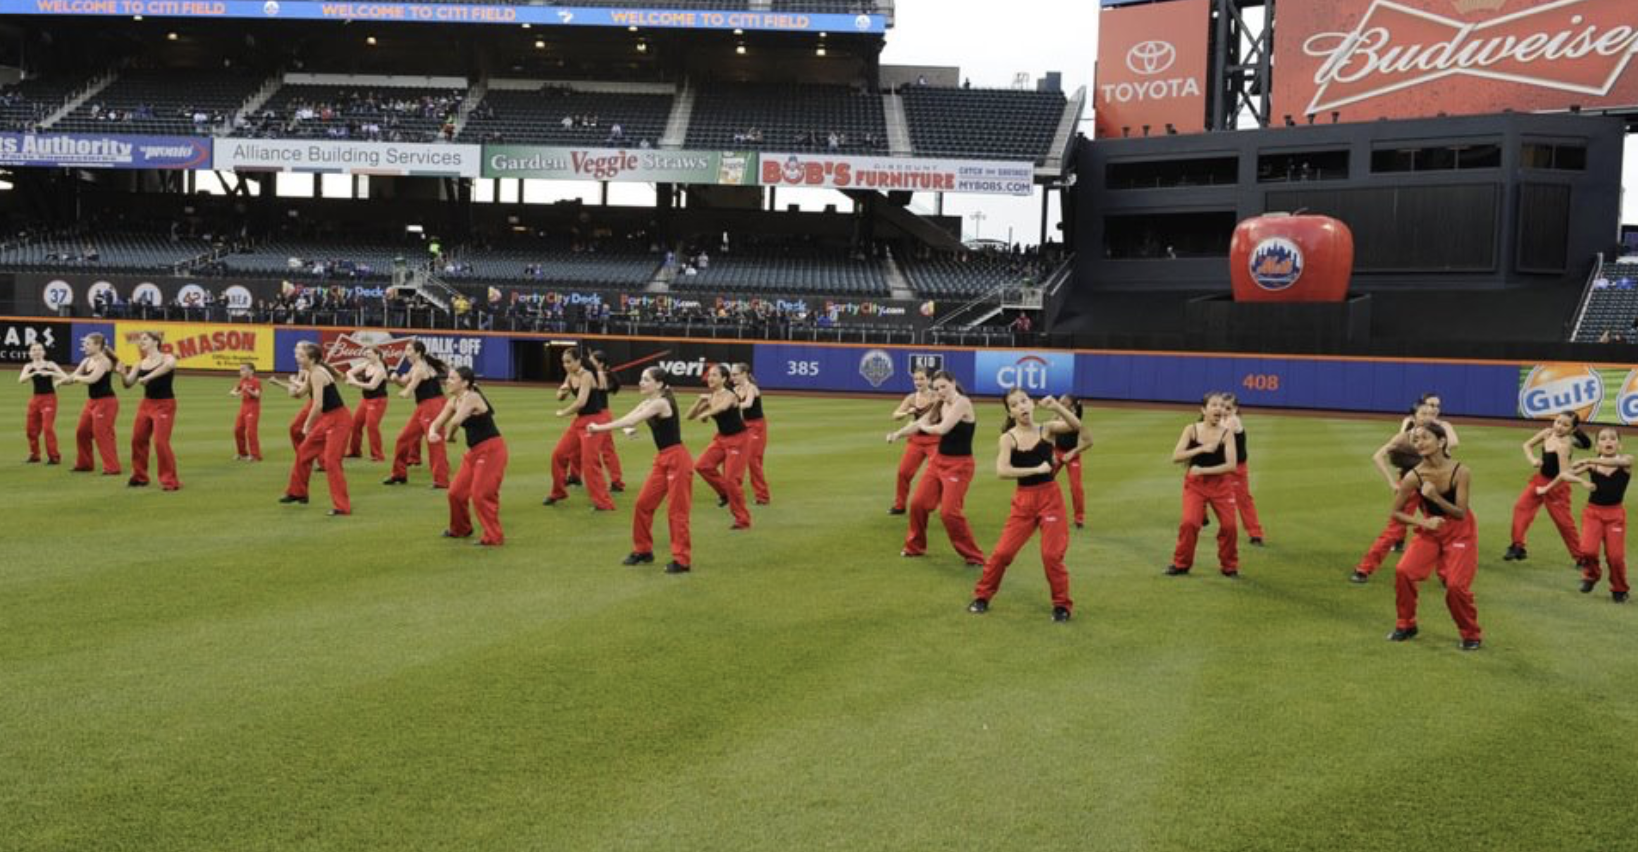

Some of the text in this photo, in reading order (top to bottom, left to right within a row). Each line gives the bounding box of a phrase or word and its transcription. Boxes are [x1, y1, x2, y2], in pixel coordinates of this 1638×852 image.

[37, 0, 226, 14] WELCOME TO CITI FIELD
[322, 4, 516, 20] WELCOME TO CITI FIELD
[611, 11, 809, 28] WELCOME TO CITI FIELD
[1101, 77, 1200, 103] TOYOTA
[22, 135, 132, 159] Authority
[233, 144, 462, 166] Alliance Building Services
[491, 150, 708, 178] Garden Veggie Straws
[762, 159, 852, 186] BOB'S
[855, 170, 955, 190] FURNITURE
[959, 181, 1030, 192] MYBOBS.COM
[50, 288, 68, 304] 37
[184, 291, 201, 305] 42
[571, 293, 601, 305] Deck
[4, 326, 55, 347] ARS
[787, 360, 819, 376] 385
[1242, 373, 1279, 391] 408
[1526, 380, 1596, 411] Gulf
